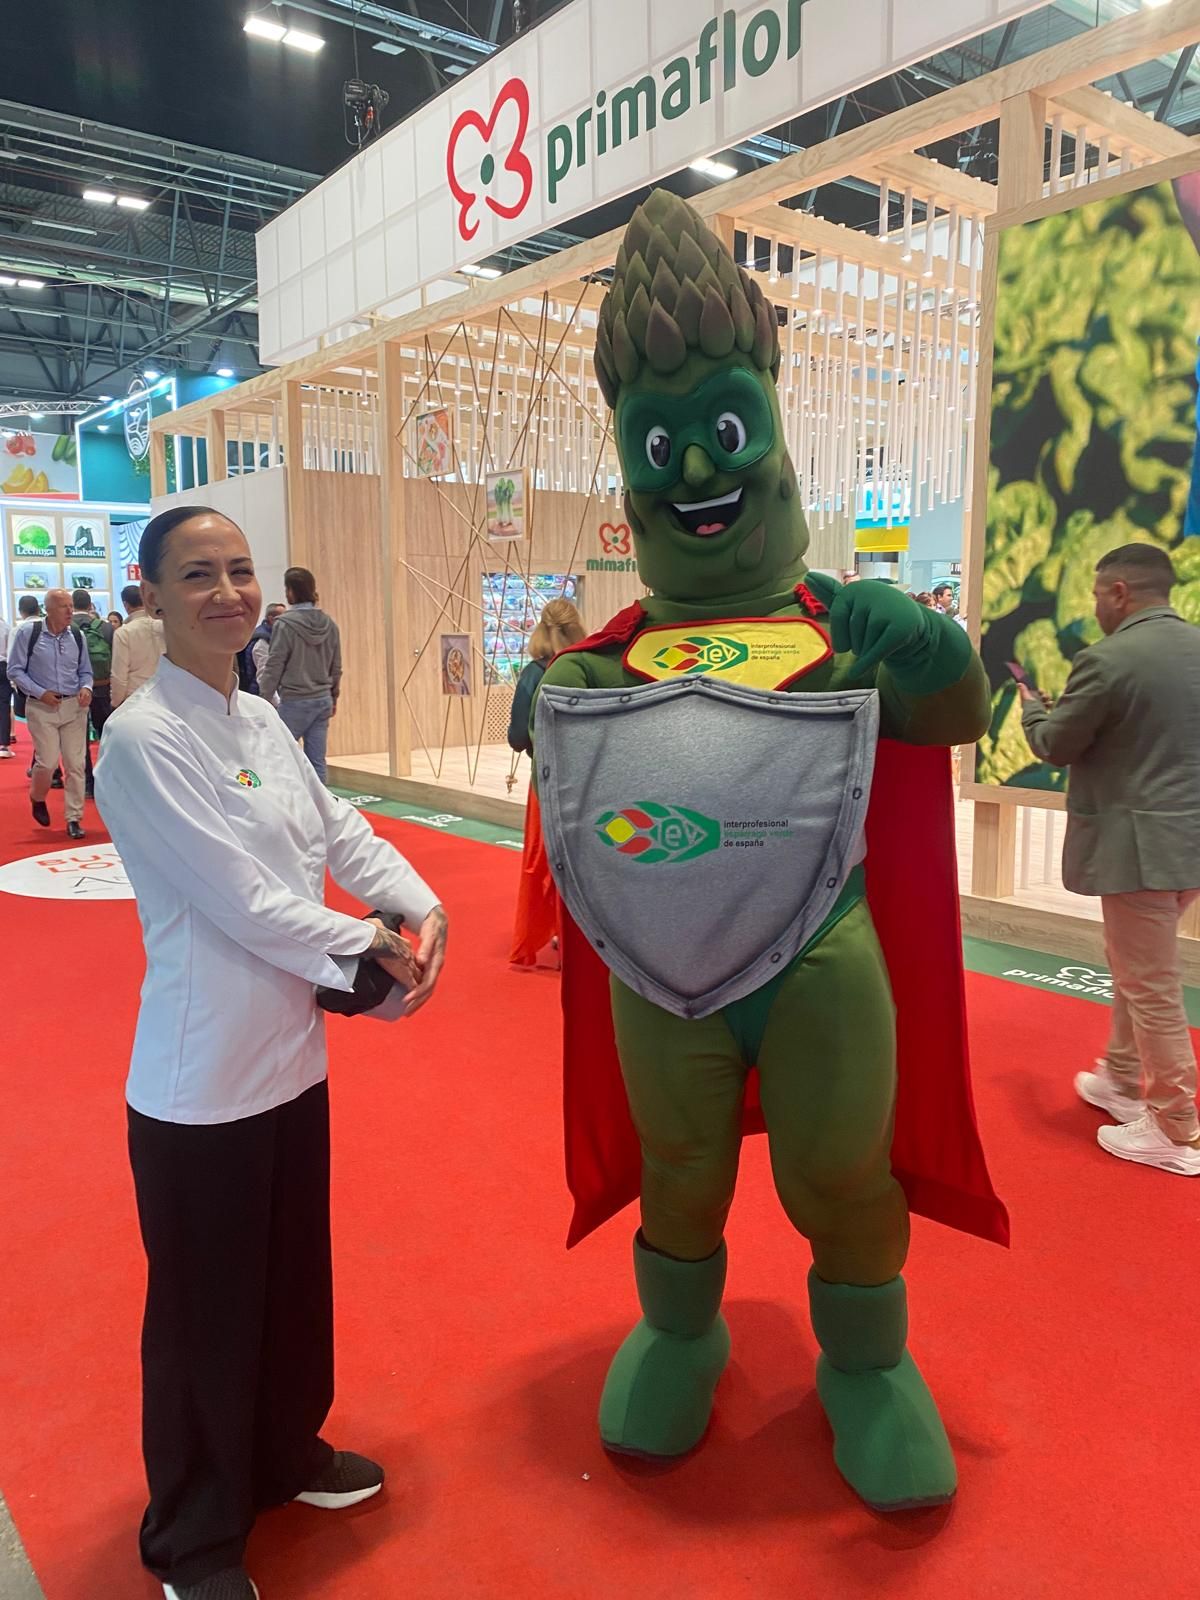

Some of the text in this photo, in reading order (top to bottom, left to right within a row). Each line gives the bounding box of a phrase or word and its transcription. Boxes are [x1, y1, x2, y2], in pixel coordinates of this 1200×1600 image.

[547, 0, 810, 204] primaflor
[586, 557, 636, 572] mimafl
[723, 818, 789, 829] interprofesional
[723, 838, 764, 849] de españa
